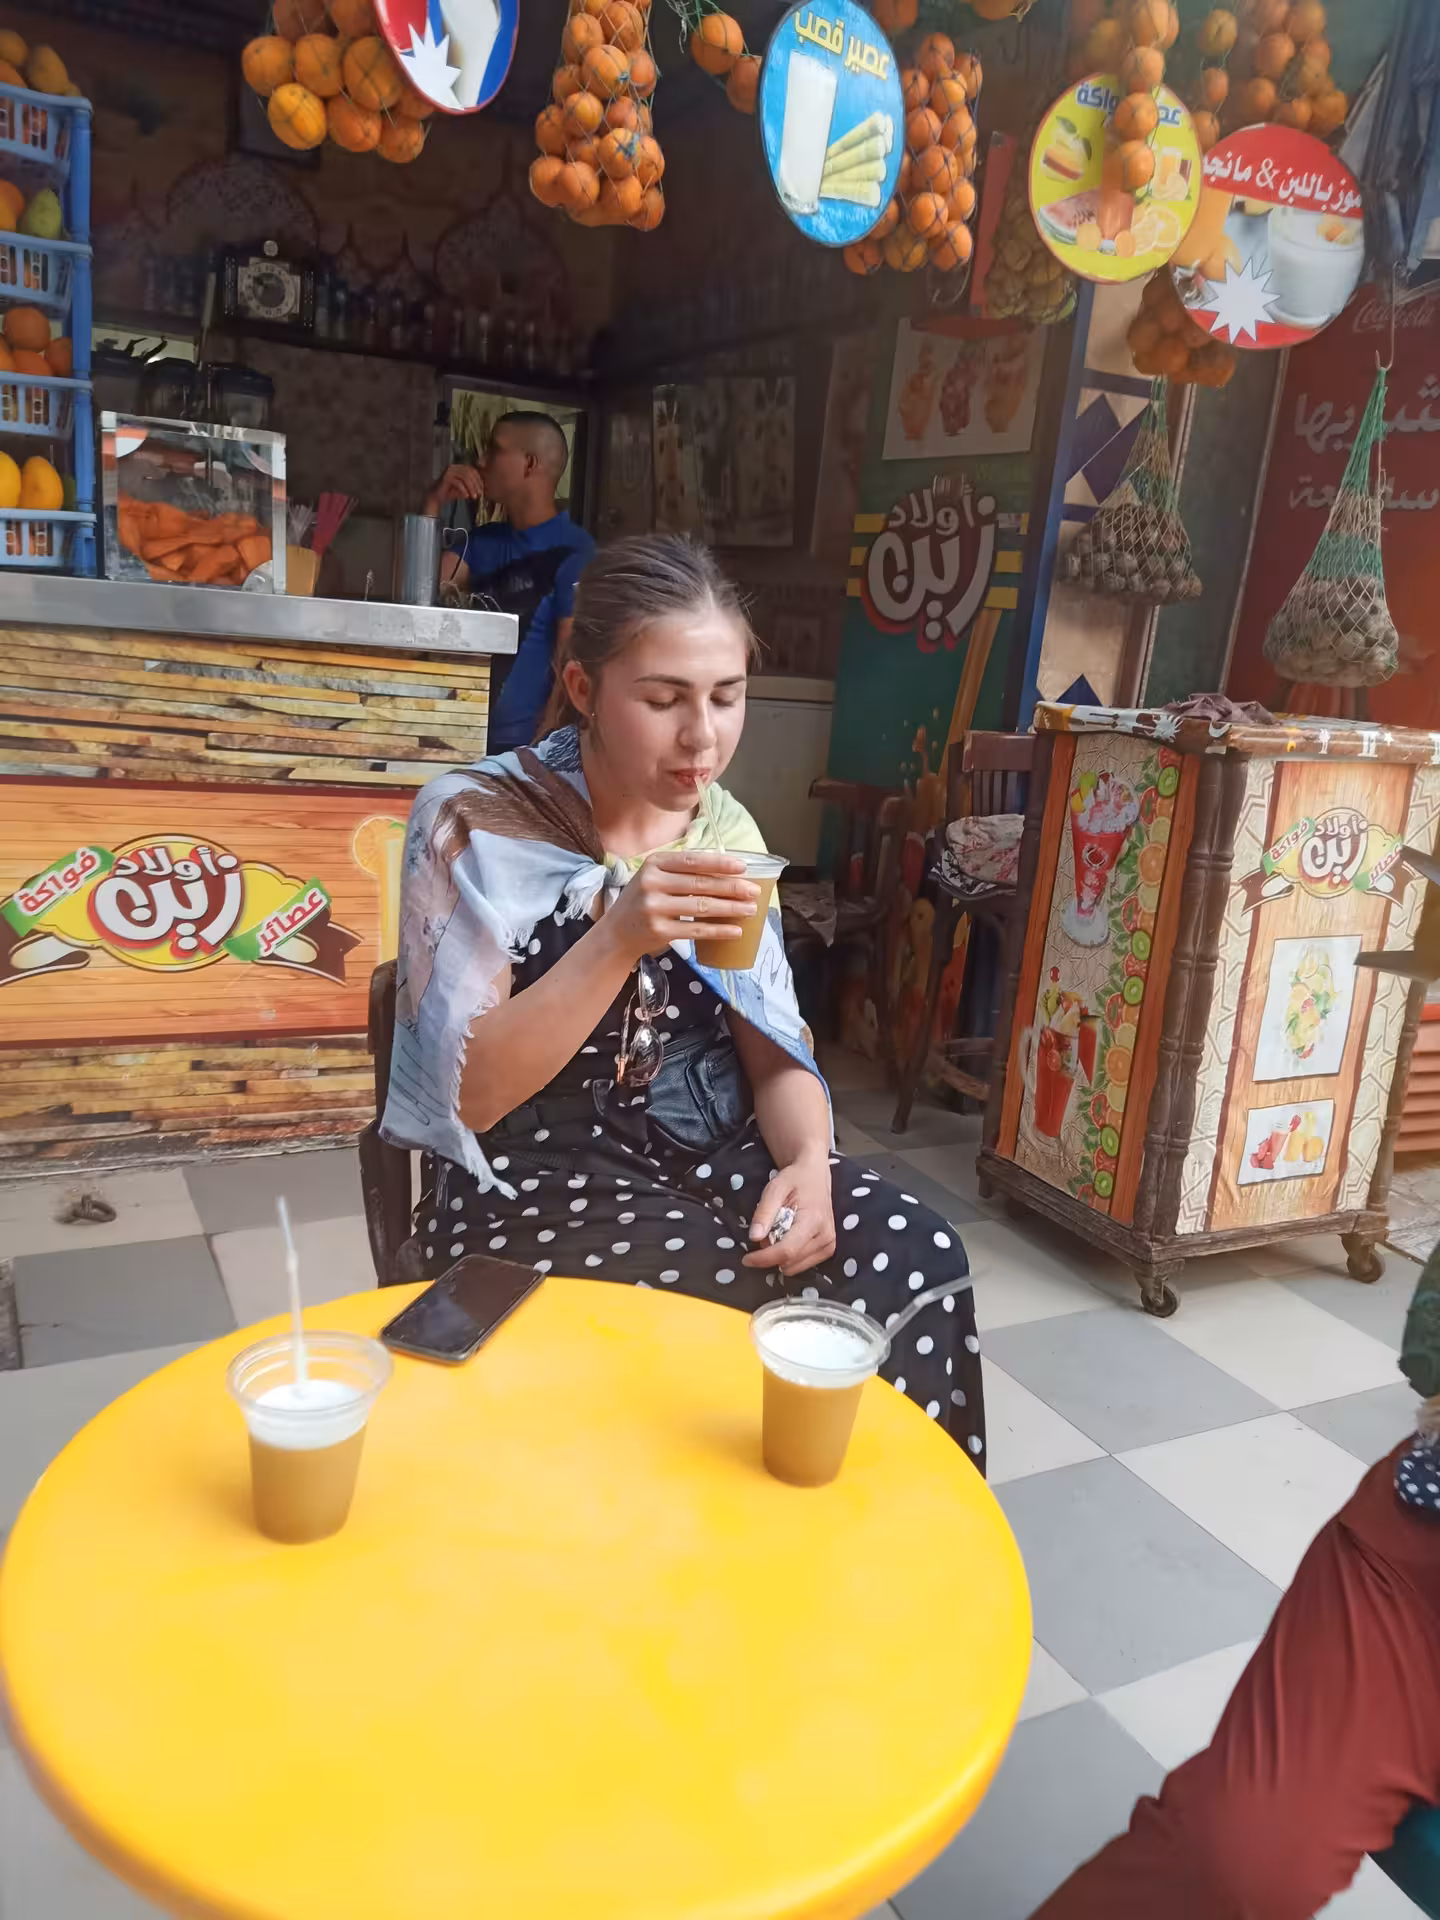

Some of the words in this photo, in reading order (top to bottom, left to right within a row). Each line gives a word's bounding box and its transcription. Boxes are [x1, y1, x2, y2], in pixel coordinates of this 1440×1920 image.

[795, 11, 844, 55] قصب
[844, 35, 889, 81] عصير
[1255, 157, 1280, 190] &
[1278, 166, 1333, 212] باللبن
[1353, 298, 1435, 333] CocaCola
[868, 496, 995, 640] زين
[116, 846, 219, 880] أولاد
[1271, 820, 1309, 861] فواكة
[1301, 819, 1368, 884] زين
[18, 851, 97, 912] فواكة
[94, 855, 241, 950] زين
[260, 891, 323, 953] عصائر
